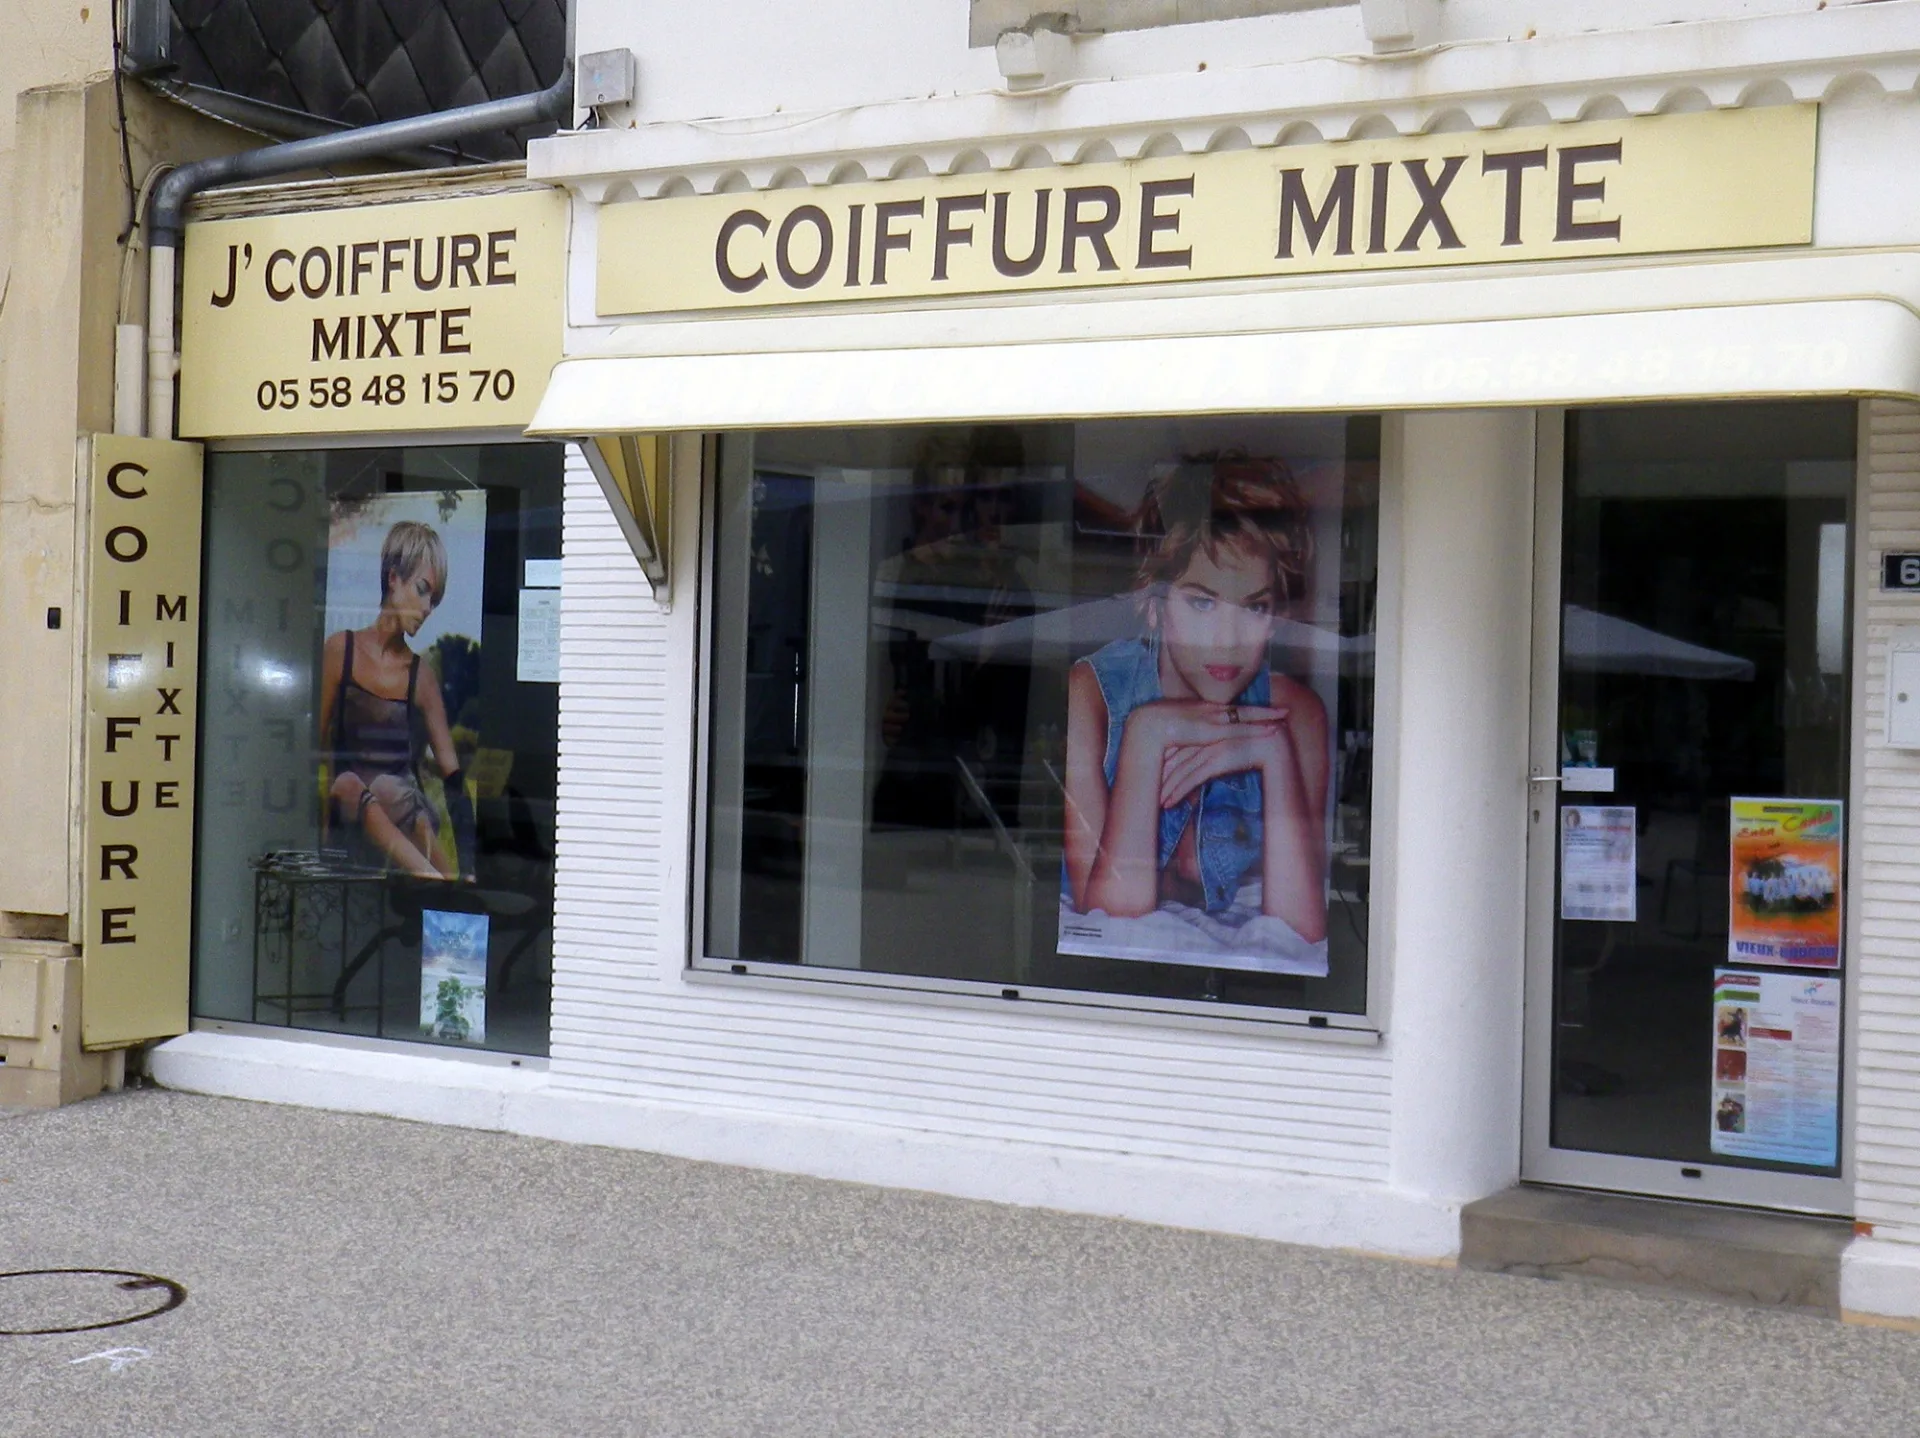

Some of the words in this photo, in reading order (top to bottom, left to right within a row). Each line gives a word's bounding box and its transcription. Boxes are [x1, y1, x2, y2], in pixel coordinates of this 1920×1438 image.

[715, 172, 1195, 294] COIFFURE
[1274, 137, 1622, 260] MIXTE
[257, 379, 299, 410] 05
[309, 377, 351, 408] 58
[362, 374, 405, 405] 48
[422, 372, 458, 403] 15
[470, 369, 514, 401] 70
[312, 307, 470, 361] MIXTE
[100, 461, 149, 945] COIFFURE
[154, 593, 188, 809] MIXTE
